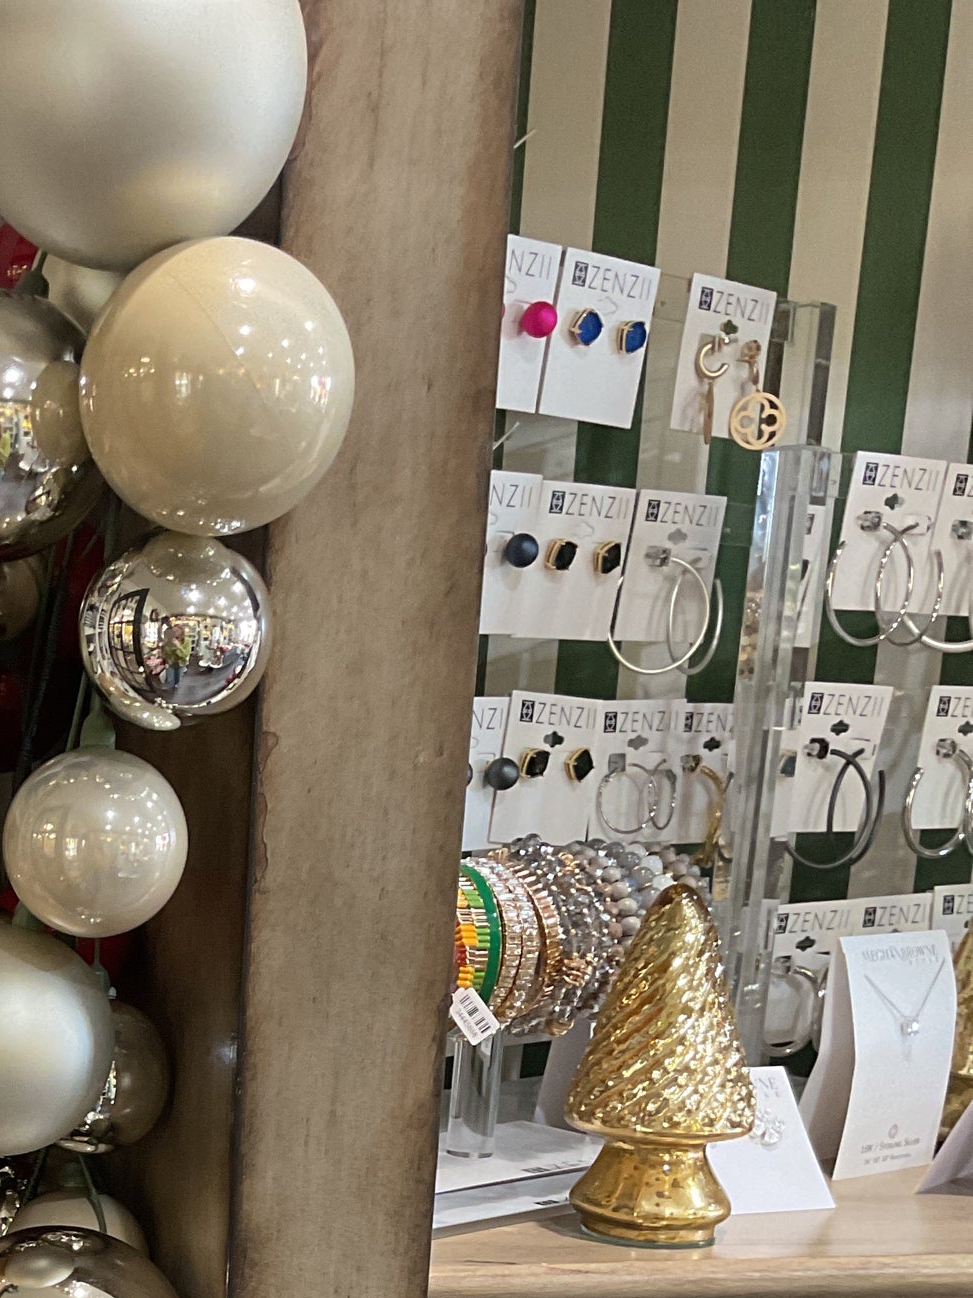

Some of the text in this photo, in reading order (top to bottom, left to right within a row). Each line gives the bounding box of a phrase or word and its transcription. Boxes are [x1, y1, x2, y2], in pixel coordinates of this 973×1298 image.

[509, 249, 553, 280] NZII
[588, 266, 653, 301] ZENZII
[712, 290, 770, 325] ZENZII
[877, 464, 941, 492] ZENZII
[490, 484, 533, 510] NZII
[565, 492, 629, 520] ZENZII
[659, 501, 720, 528] ZENZII
[473, 707, 504, 730] NZI
[535, 702, 597, 730] ZENZII
[823, 693, 884, 718] ZENZII
[619, 710, 679, 733] ZENZII
[788, 909, 851, 934] ZENZII
[877, 903, 926, 927] ZENZI
